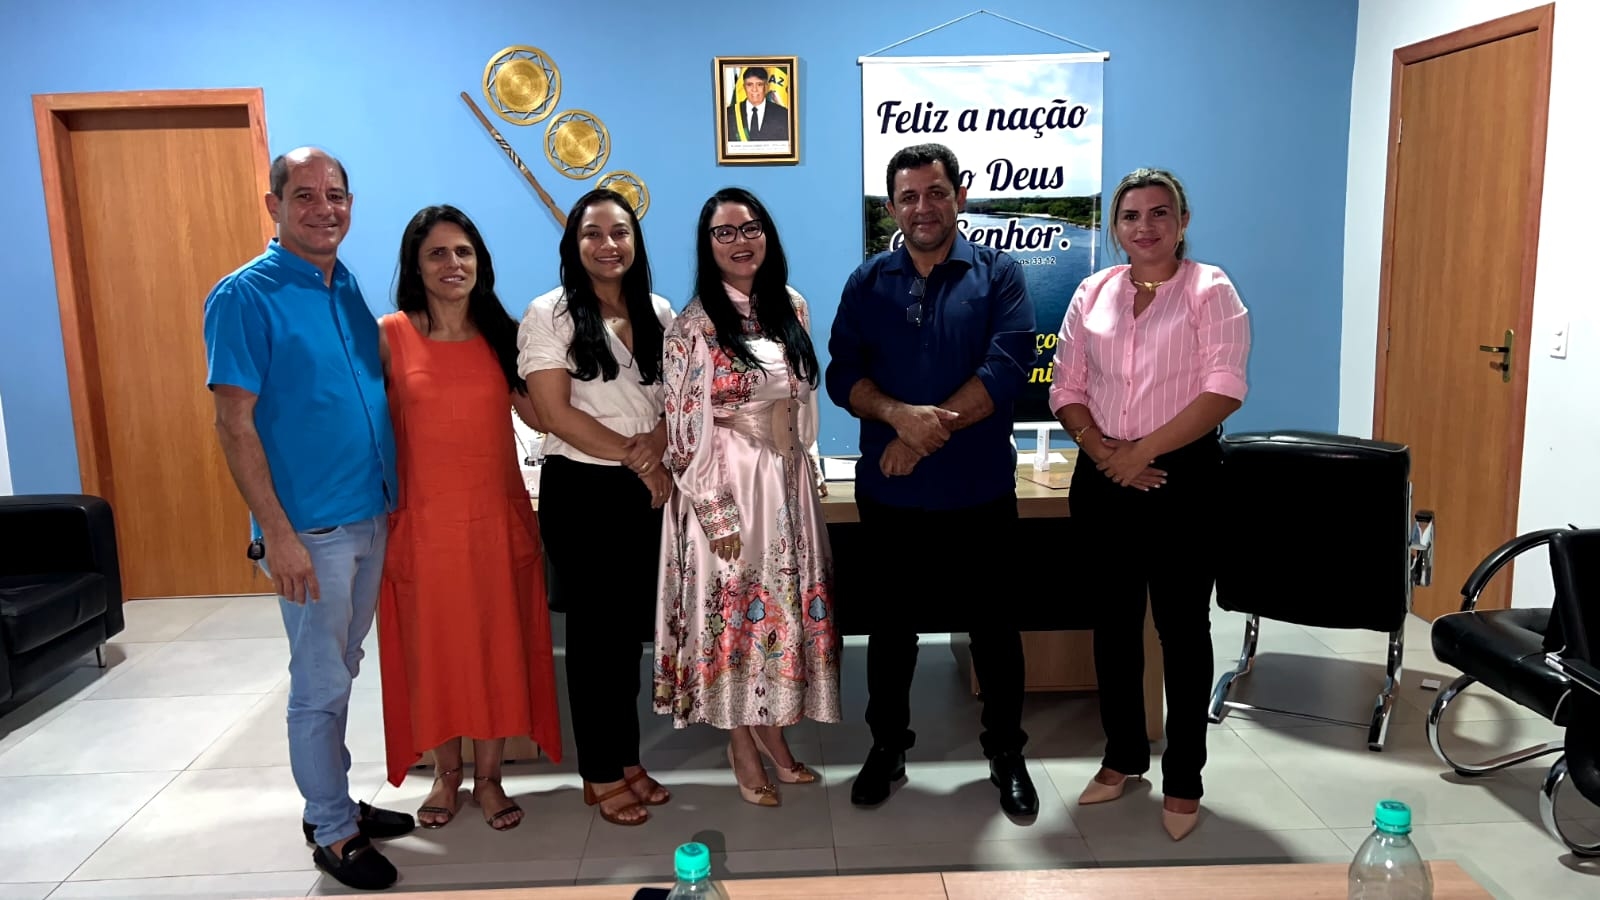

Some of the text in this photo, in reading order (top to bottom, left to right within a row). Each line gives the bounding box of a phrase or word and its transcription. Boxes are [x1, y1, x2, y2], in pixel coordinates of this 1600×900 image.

[877, 98, 1089, 139] Feliz a nação
[986, 158, 1064, 191] Deus
